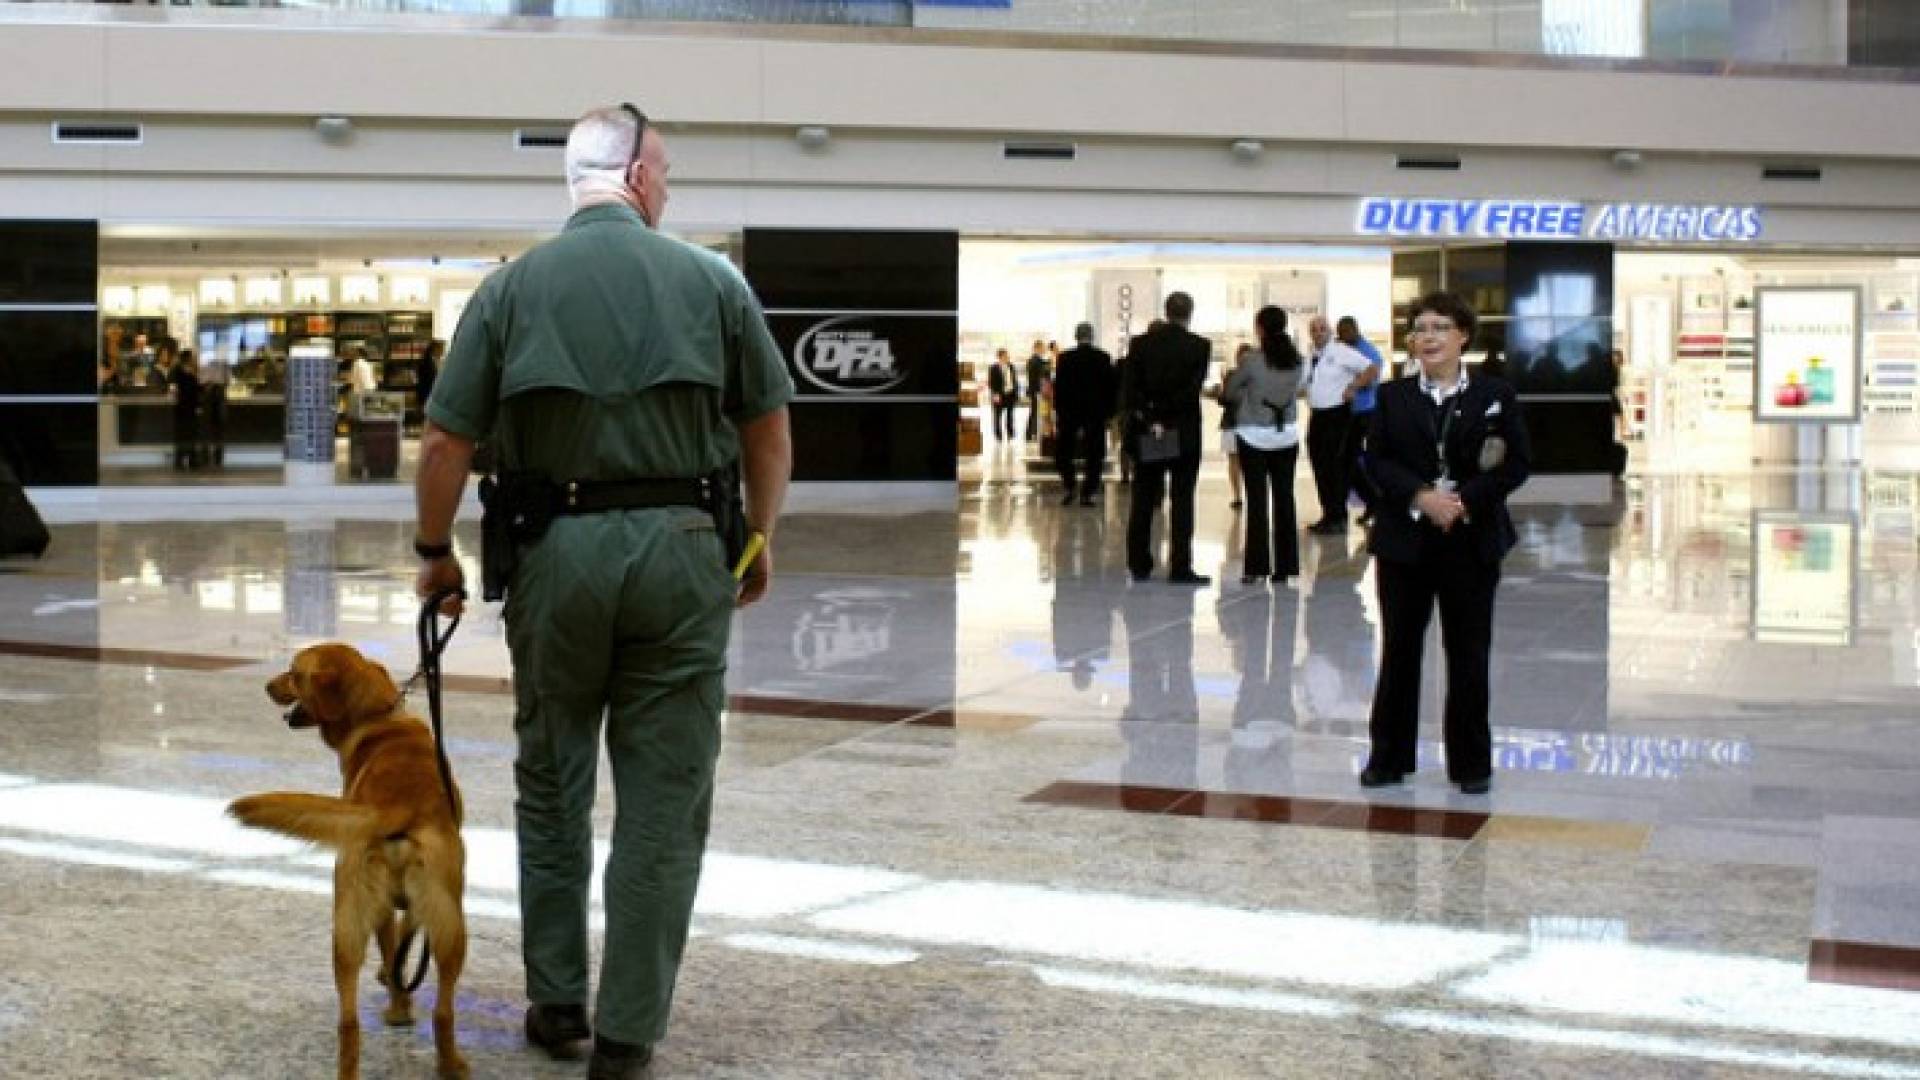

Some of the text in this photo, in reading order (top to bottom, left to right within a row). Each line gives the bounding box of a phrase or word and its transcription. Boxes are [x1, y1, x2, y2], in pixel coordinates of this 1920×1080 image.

[1358, 198, 1763, 240] DUTY FREE AMERICAS
[812, 339, 894, 378] DFA
